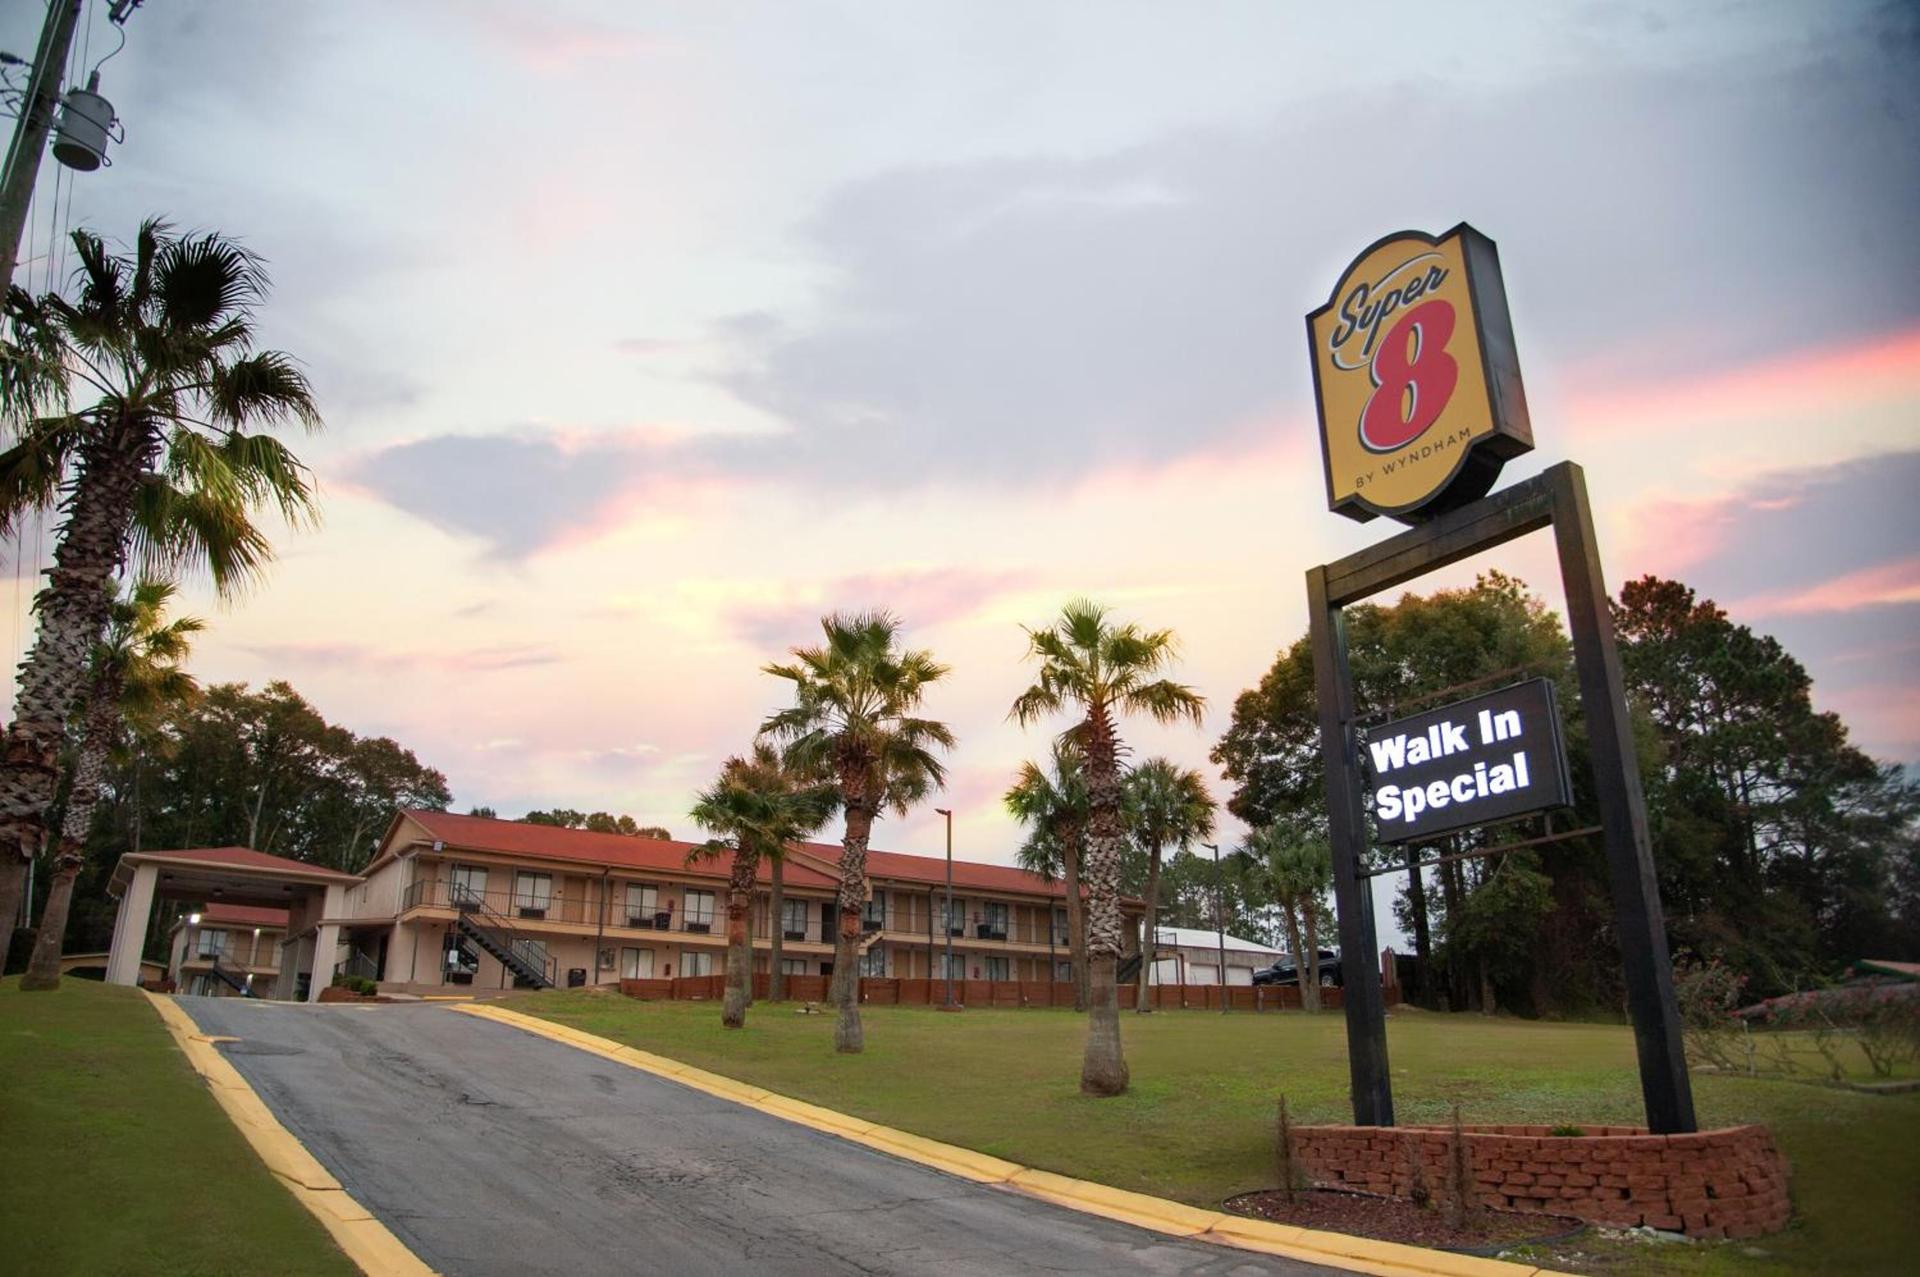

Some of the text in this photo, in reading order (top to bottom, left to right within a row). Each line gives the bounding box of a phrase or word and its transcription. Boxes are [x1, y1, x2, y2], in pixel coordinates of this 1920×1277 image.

[1330, 264, 1449, 358] Super
[1358, 299, 1459, 454] 8
[1355, 427, 1471, 489] BY WYNDHAM
[1370, 709, 1522, 773] Walk In
[1376, 751, 1530, 822] Special
